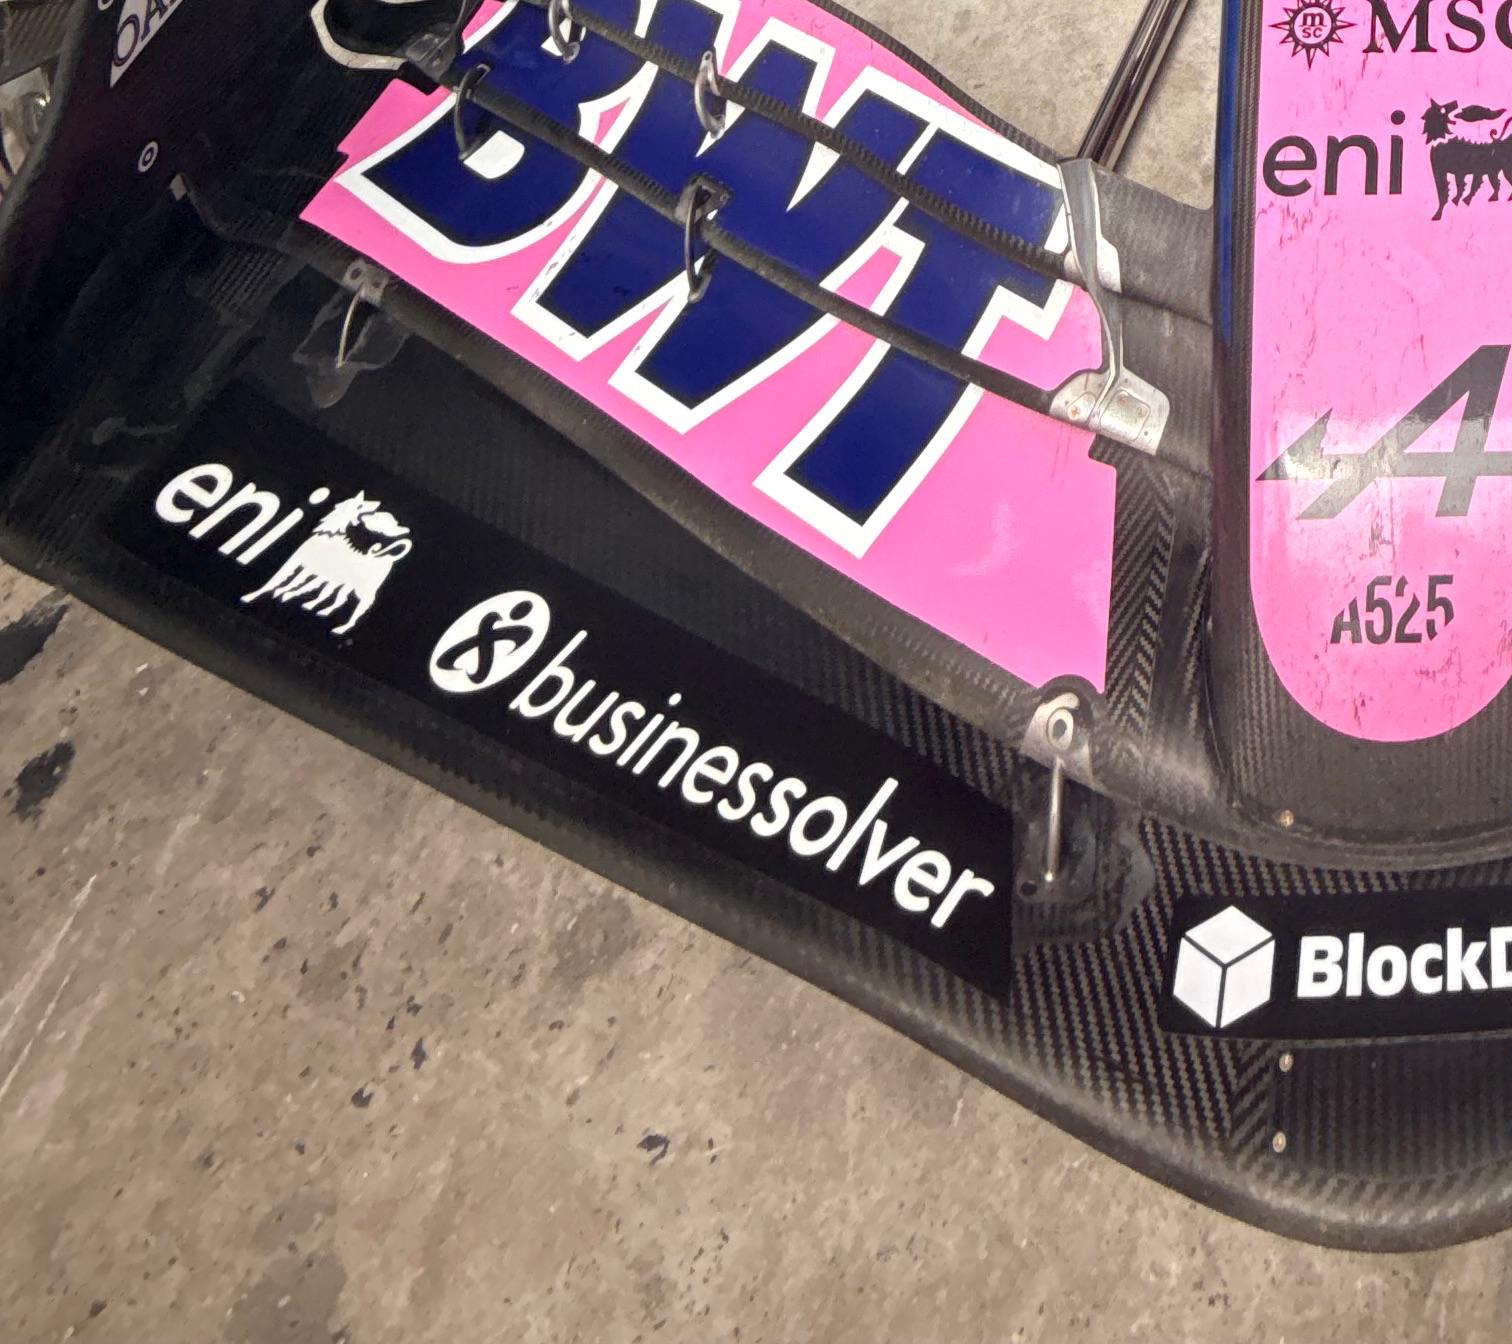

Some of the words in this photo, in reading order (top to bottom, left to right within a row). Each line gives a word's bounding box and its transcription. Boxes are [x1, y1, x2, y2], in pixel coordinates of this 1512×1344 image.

[1262, 109, 1406, 197] eni
[155, 463, 331, 565] eni
[1329, 574, 1455, 645] A525
[508, 630, 995, 930] businessolver
